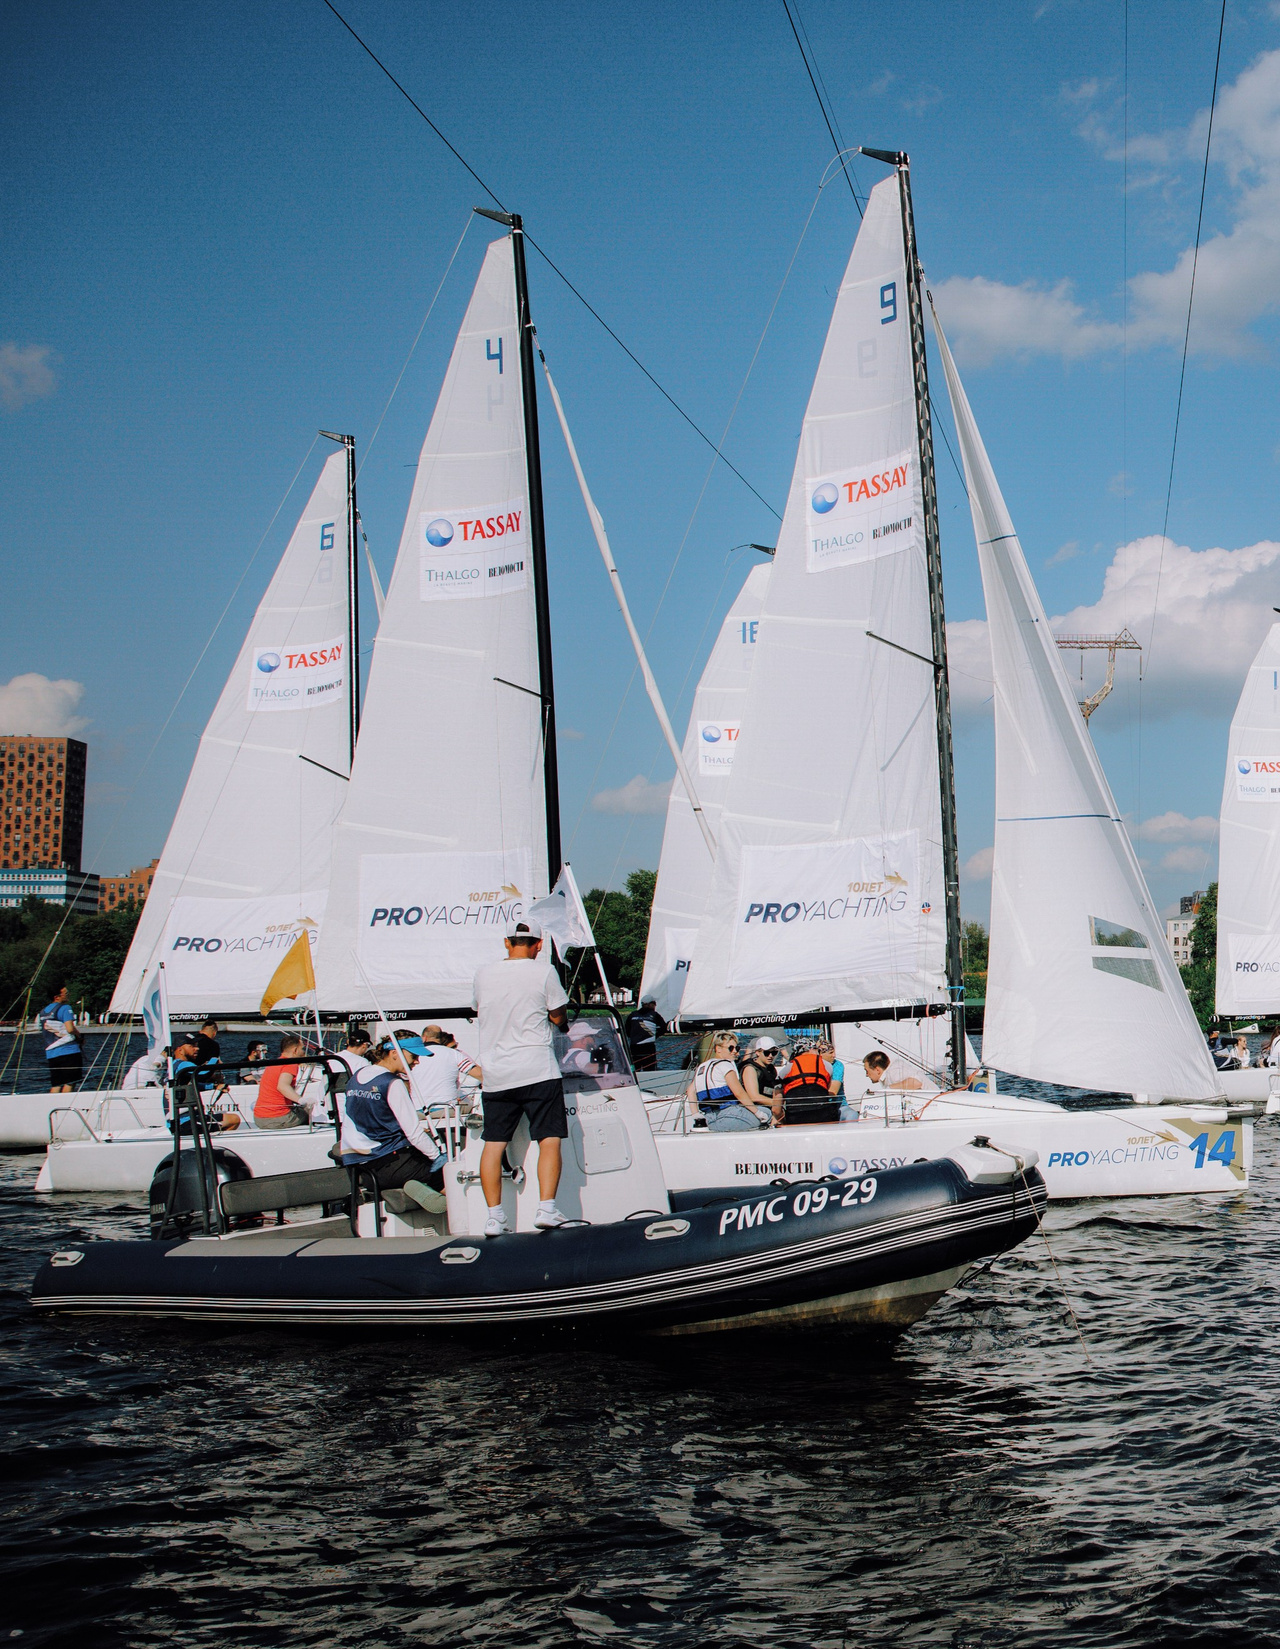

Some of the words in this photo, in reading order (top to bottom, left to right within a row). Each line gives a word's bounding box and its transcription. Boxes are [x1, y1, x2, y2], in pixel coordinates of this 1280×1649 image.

[881, 282, 897, 325] 9
[486, 338, 503, 374] 4
[843, 463, 908, 503] TASSAY
[320, 522, 334, 550] 6
[458, 511, 522, 541] TASSAY
[812, 532, 864, 552] THALGO
[426, 569, 480, 582] THALGO
[285, 643, 343, 669] TASSAY
[253, 688, 299, 697] THALGO
[370, 903, 522, 926] PROYACHTING
[744, 892, 907, 923] PROYACHTING
[348, 1011, 407, 1021] pro-yacing.ru
[734, 1013, 797, 1027] pro-yachting.ru
[565, 1103, 618, 1116] ROYACHTING
[1048, 1144, 1179, 1167] PROYACHTING
[1189, 1131, 1236, 1168] 14
[850, 1157, 907, 1171] TASSAY
[793, 1177, 877, 1216] 09-29
